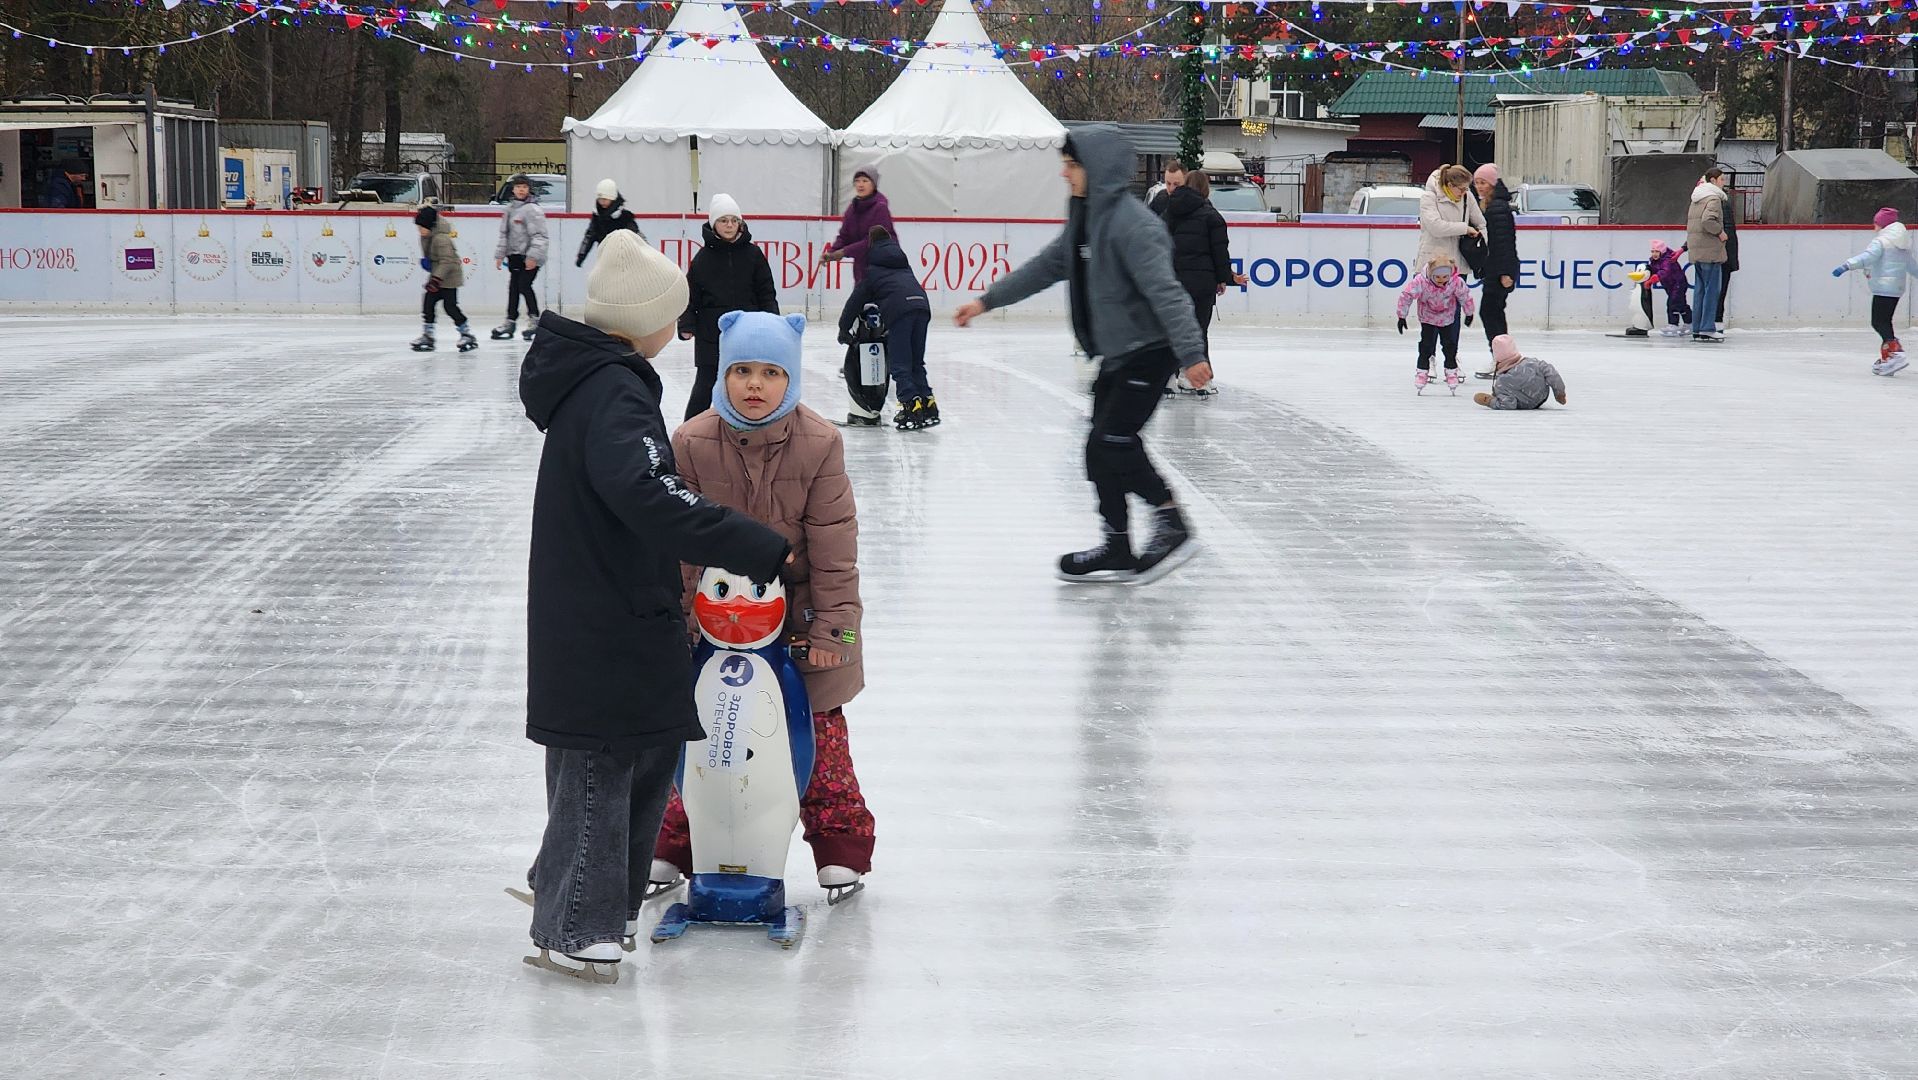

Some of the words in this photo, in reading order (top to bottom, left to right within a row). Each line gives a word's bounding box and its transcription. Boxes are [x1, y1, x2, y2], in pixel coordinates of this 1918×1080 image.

[251, 257, 284, 265] BOXER
[920, 242, 1011, 291] 2025
[1225, 257, 1408, 293] ДОРОВО
[708, 691, 727, 768] ОТЕЧЕСТВО
[721, 693, 742, 768] ЗДОРОВОЕ
